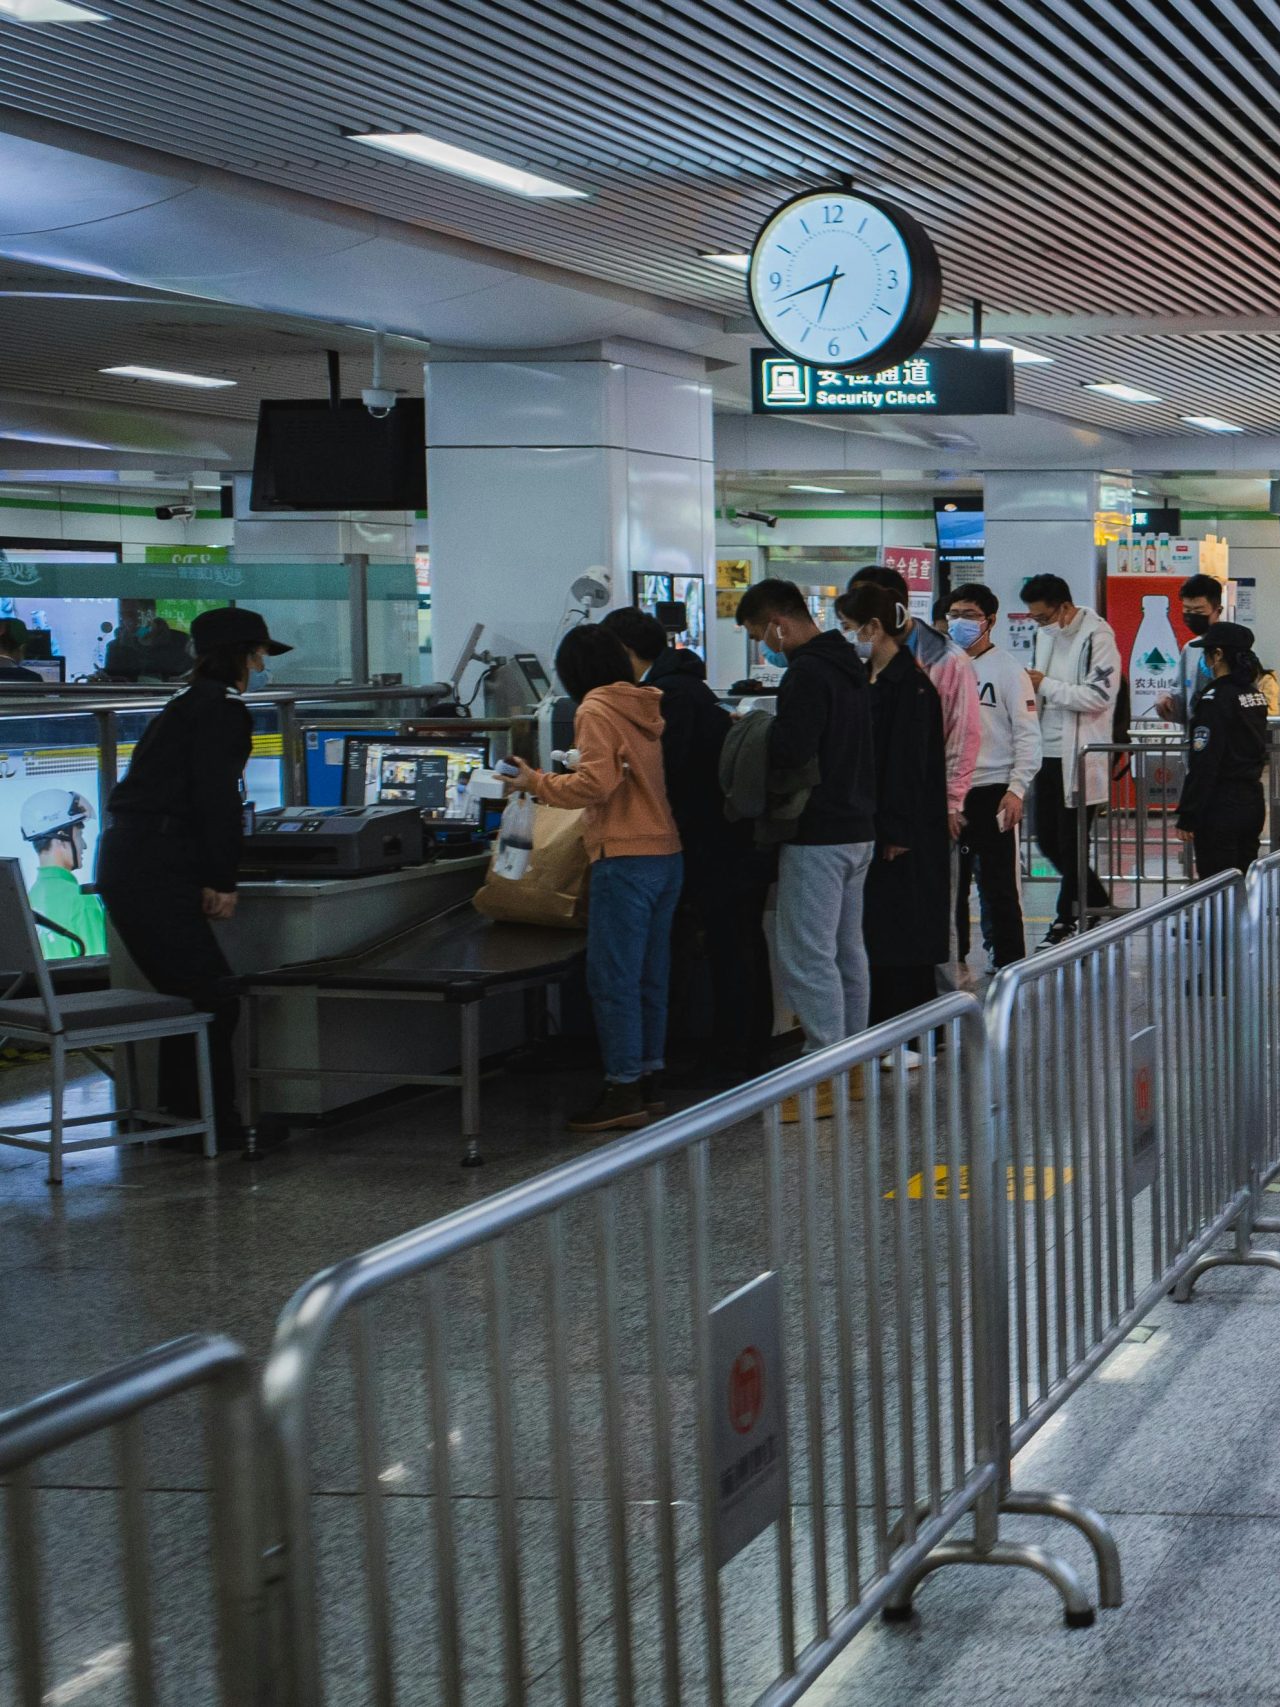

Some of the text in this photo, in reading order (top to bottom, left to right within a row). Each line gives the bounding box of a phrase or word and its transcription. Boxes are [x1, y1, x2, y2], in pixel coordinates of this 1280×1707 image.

[822, 204, 844, 224] 12
[768, 271, 783, 292] 9
[886, 269, 899, 290] 3
[827, 336, 841, 357] 6
[816, 390, 936, 408] Security Check
